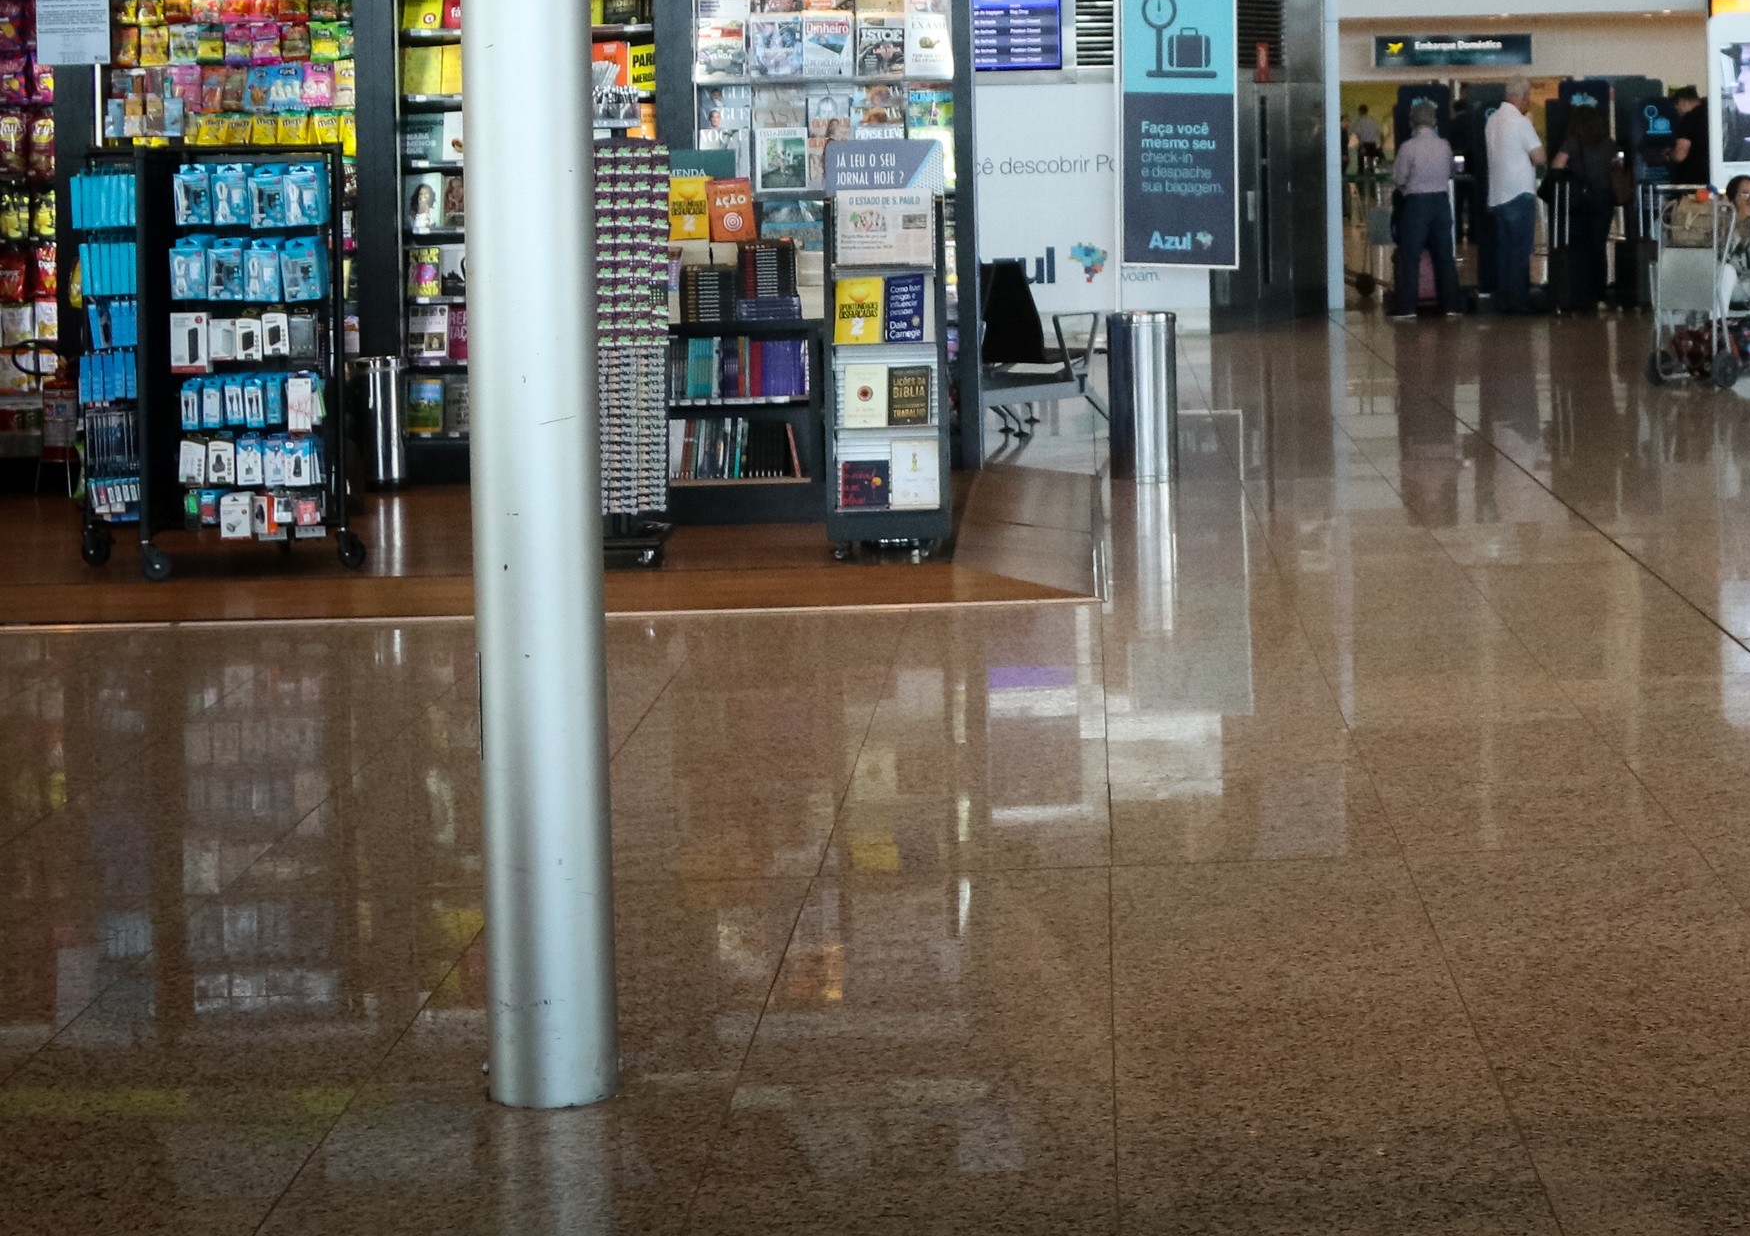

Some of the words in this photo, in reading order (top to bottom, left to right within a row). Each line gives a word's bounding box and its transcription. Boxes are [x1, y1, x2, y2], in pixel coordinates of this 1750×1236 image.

[806, 22, 849, 35] Dinheiro
[1414, 40, 1456, 51] Embarque
[1457, 39, 1502, 50] Doméstico
[1140, 120, 1173, 139] Faça
[1177, 121, 1210, 135] você
[1141, 137, 1190, 149] mesmo
[1192, 138, 1216, 150] seu
[836, 152, 846, 168] JÁ
[850, 153, 865, 167] LEU
[869, 153, 876, 167] O
[880, 153, 896, 167] SEU
[1141, 151, 1193, 163] check-in
[1000, 156, 1091, 175] descobrir
[836, 171, 869, 185] JORNAL
[874, 171, 895, 184] HOJE
[899, 171, 905, 184] ?
[1141, 167, 1150, 178] e
[1152, 165, 1212, 182] despache
[1141, 181, 1162, 192] sua
[1165, 180, 1225, 196] bagagem.
[715, 193, 747, 208] AÇÃO
[848, 196, 855, 205] O
[855, 196, 880, 205] ESTADO
[881, 196, 890, 205] DE
[899, 196, 920, 205] PAULO
[1149, 230, 1192, 250] Azul
[850, 317, 865, 336] 2
[889, 320, 907, 330] Dale
[889, 329, 921, 339] Carnegie
